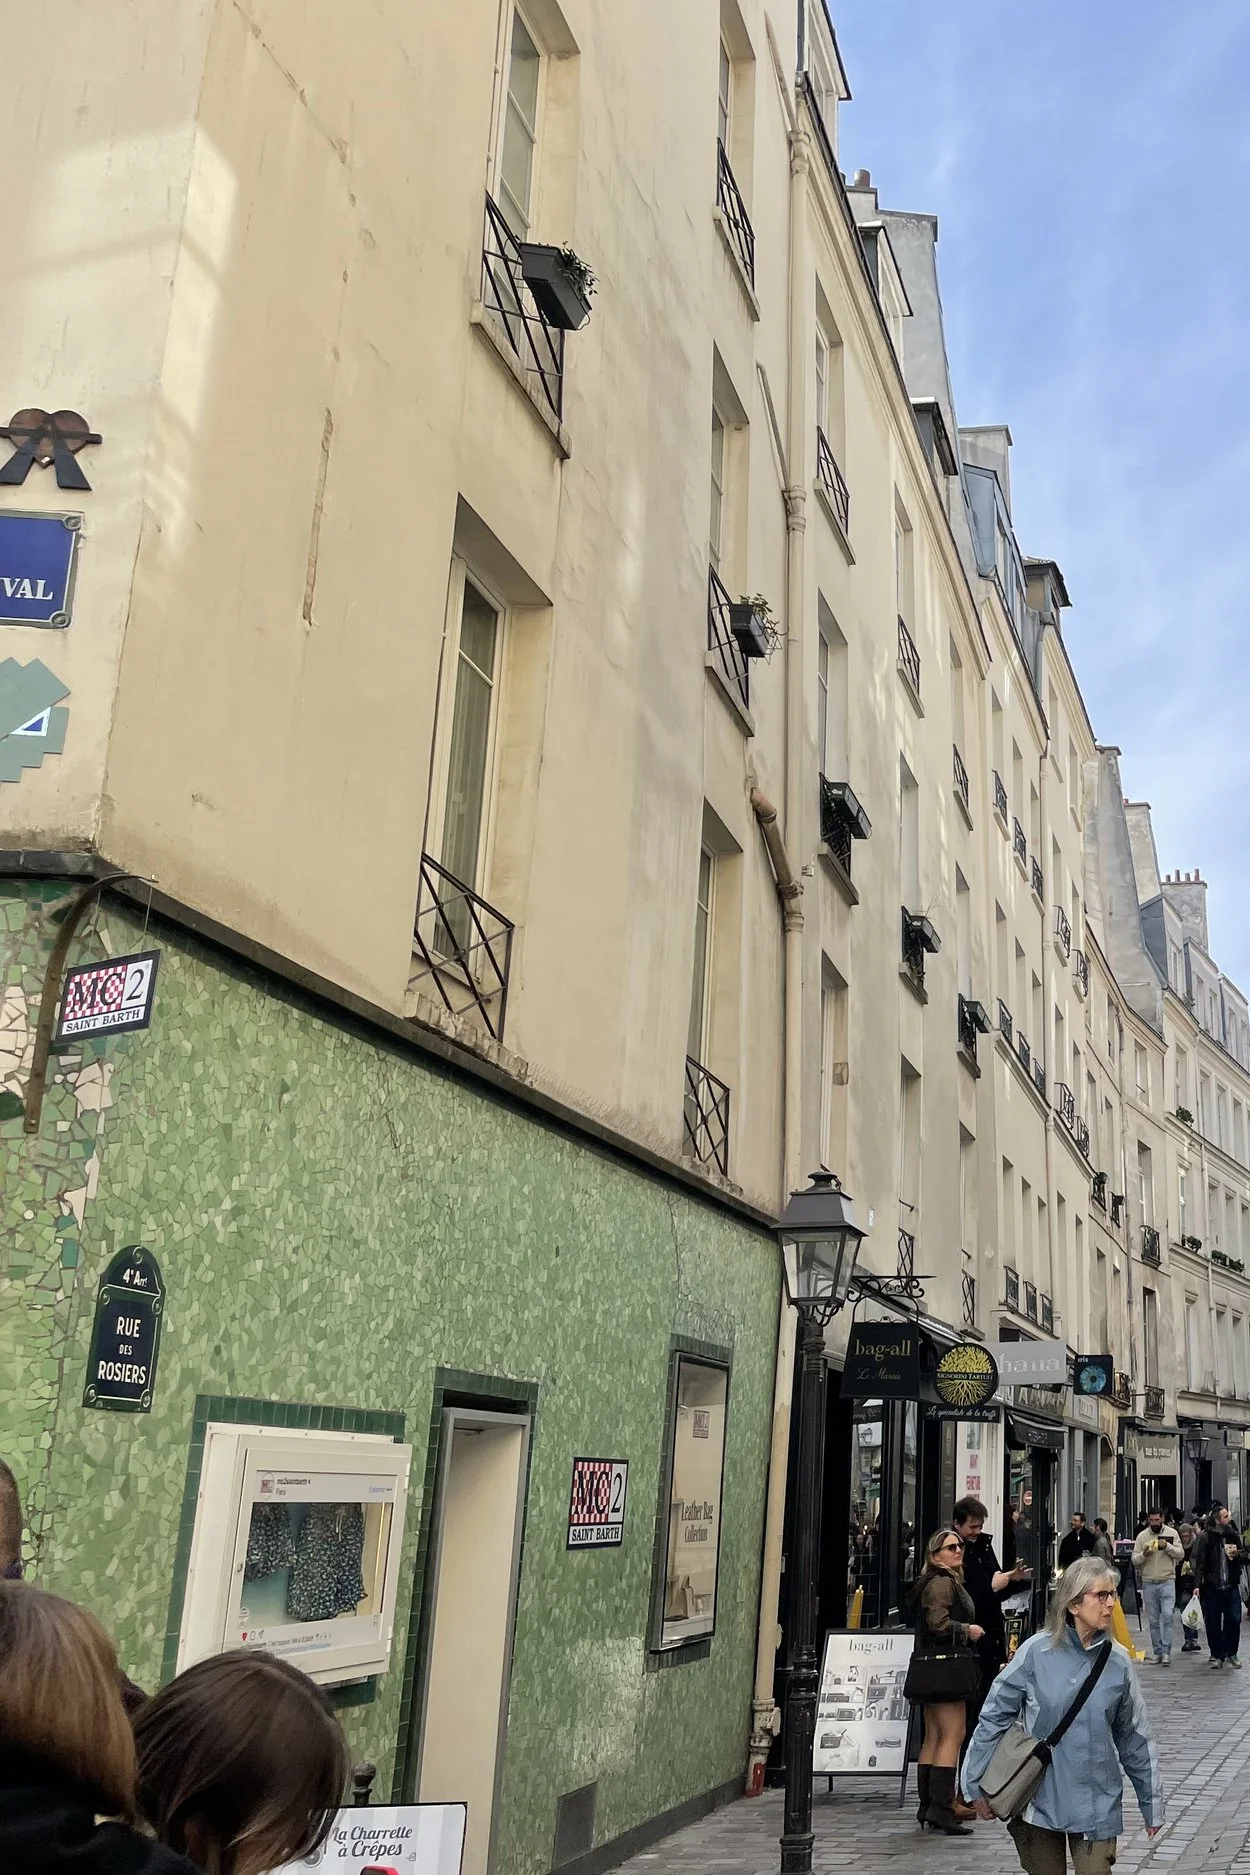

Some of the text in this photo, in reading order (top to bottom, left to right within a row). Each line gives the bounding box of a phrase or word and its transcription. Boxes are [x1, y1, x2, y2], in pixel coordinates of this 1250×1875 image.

[0, 577, 54, 600] VAL
[65, 1009, 140, 1032] SAINT BARTH
[116, 1316, 142, 1338] RUE
[119, 1344, 133, 1356] DES
[855, 1339, 911, 1361] bag-all
[97, 1360, 147, 1385] ROSIERS
[681, 1500, 713, 1524] Leather Bag
[572, 1527, 620, 1542] SAINT BARTH
[685, 1524, 708, 1543] Collection
[849, 1638, 893, 1655] bag-all
[333, 1826, 413, 1844] La Charrette
[338, 1840, 403, 1861] à Crêpes
